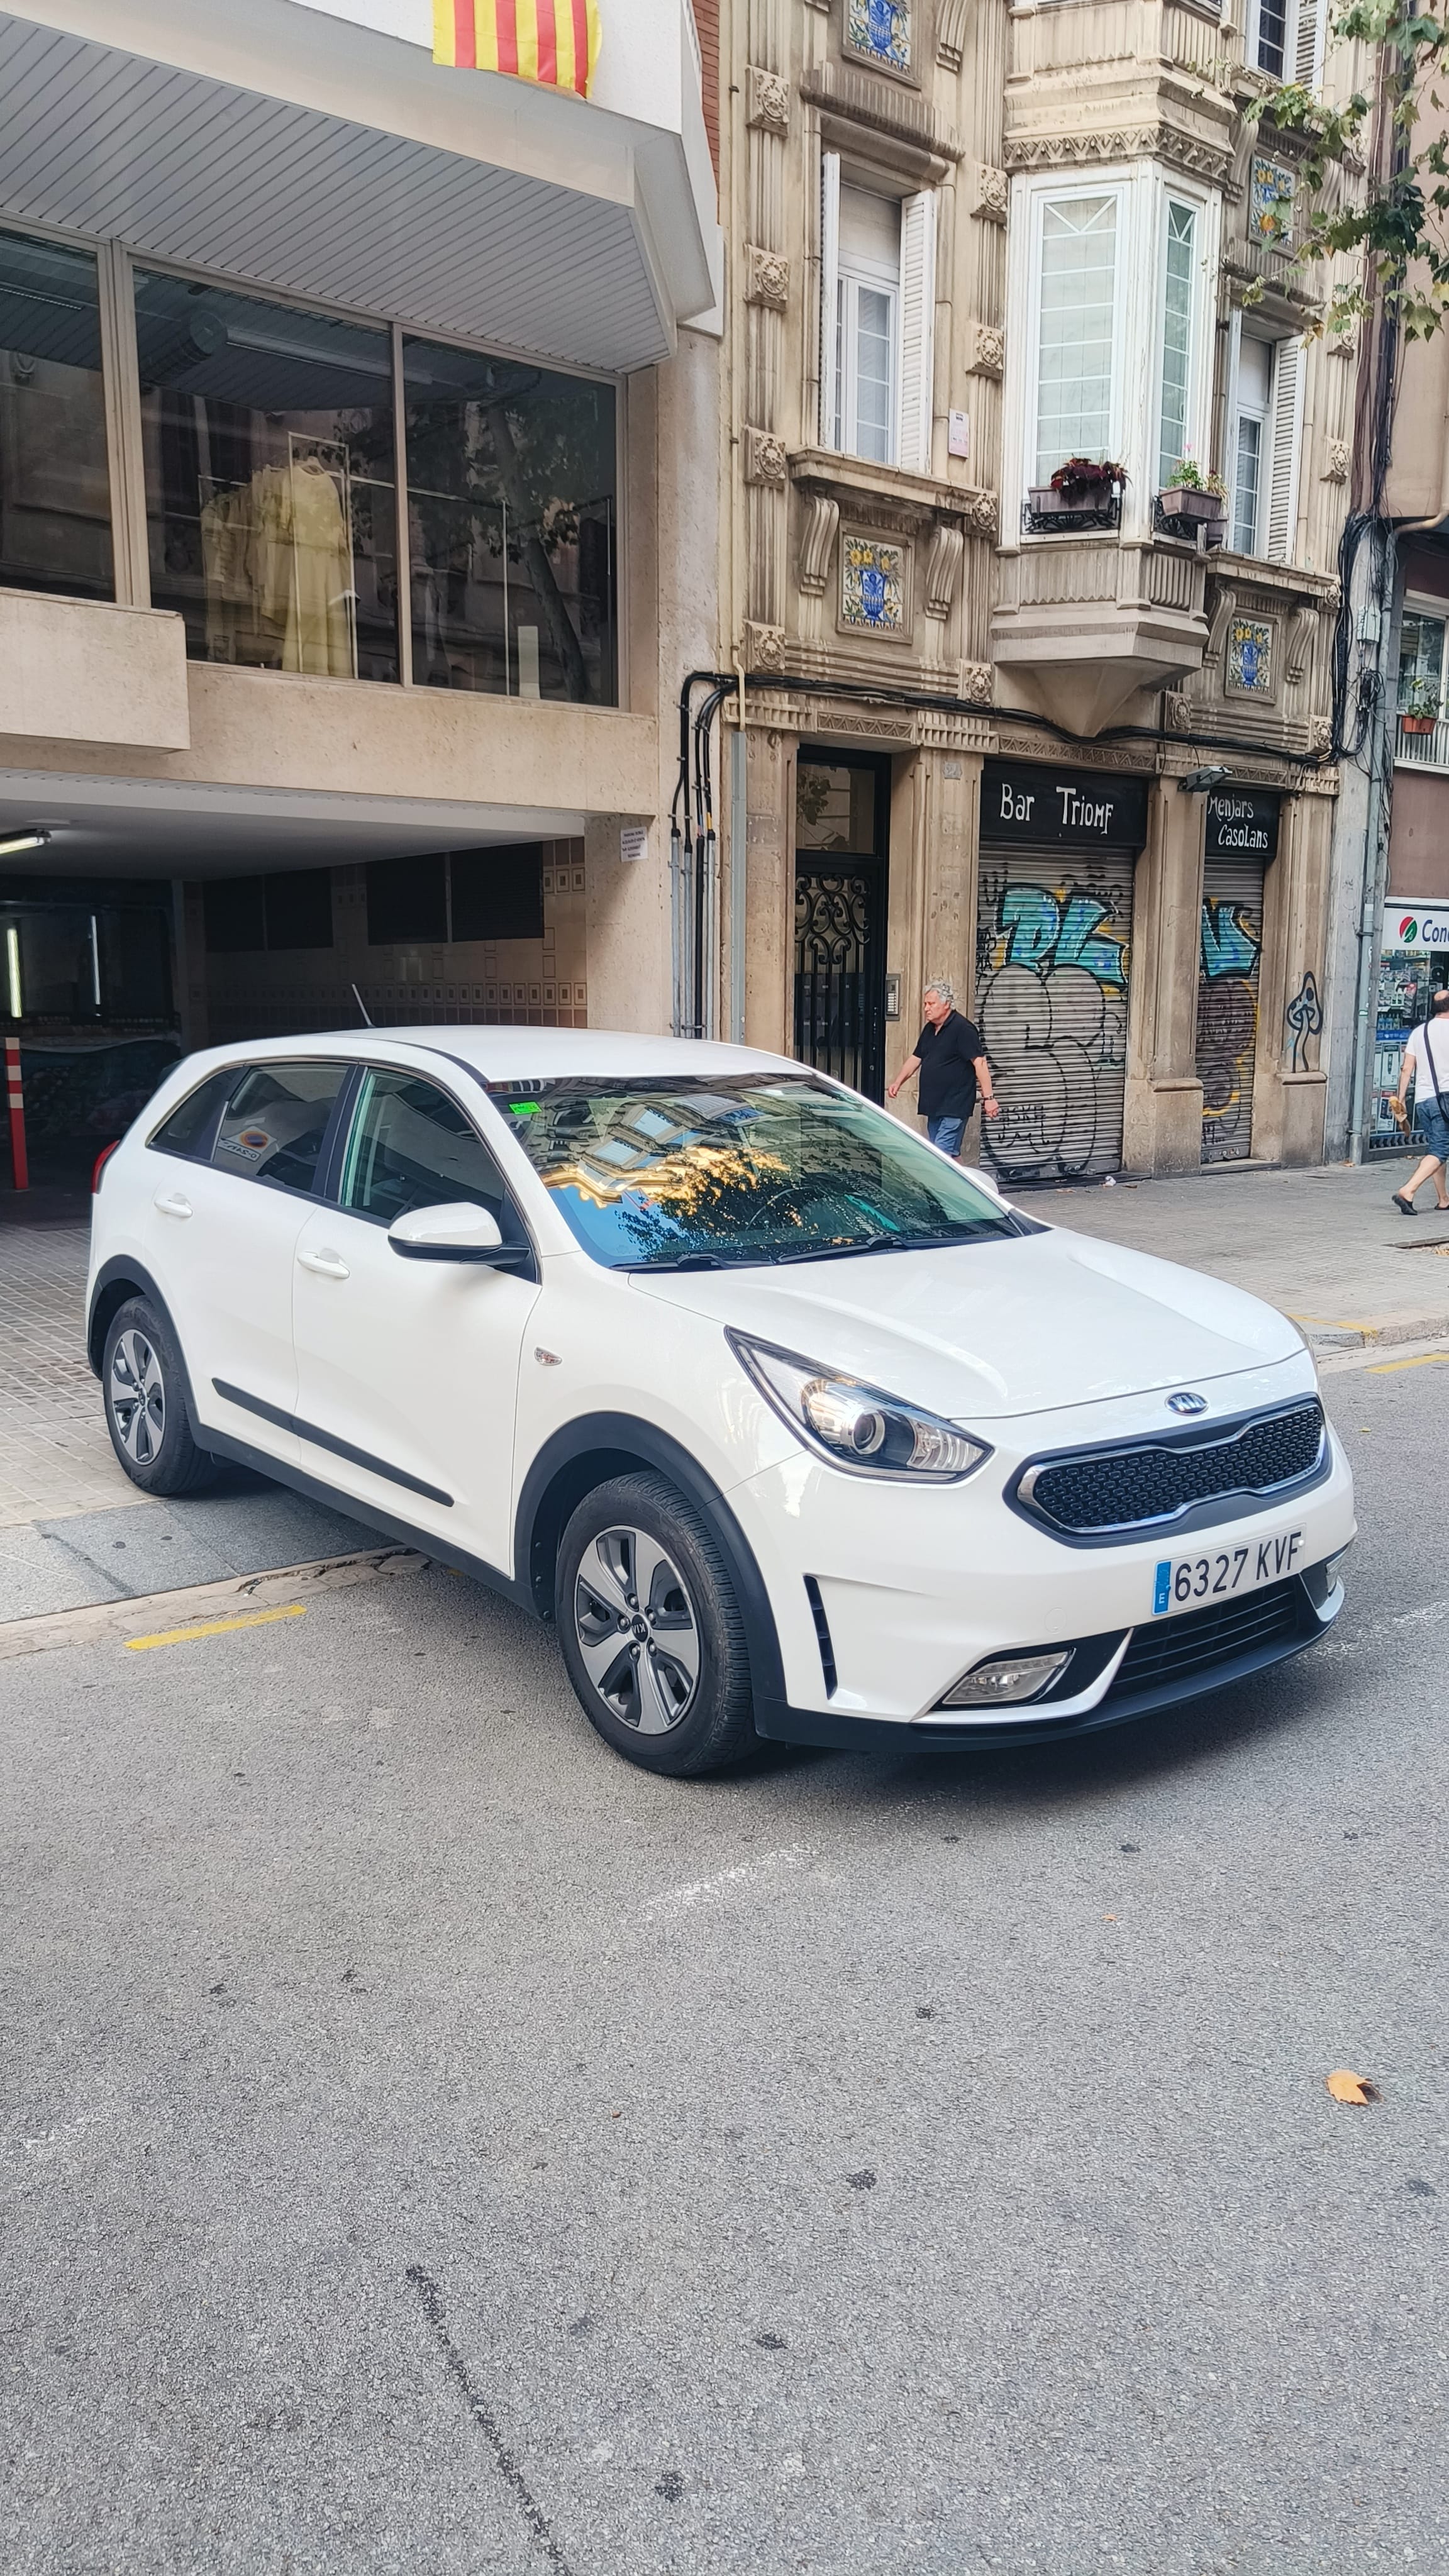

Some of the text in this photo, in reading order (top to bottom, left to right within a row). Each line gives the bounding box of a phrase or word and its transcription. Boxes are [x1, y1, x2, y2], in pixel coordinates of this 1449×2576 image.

[1000, 783, 1035, 821] Bar
[1208, 793, 1254, 821] Menjars
[1422, 919, 1449, 942] Con
[1170, 1394, 1206, 1411] KIA
[1175, 1531, 1302, 1601] 6327 KVF
[1158, 1592, 1165, 1604] E
[631, 1623, 646, 1634] KIA
